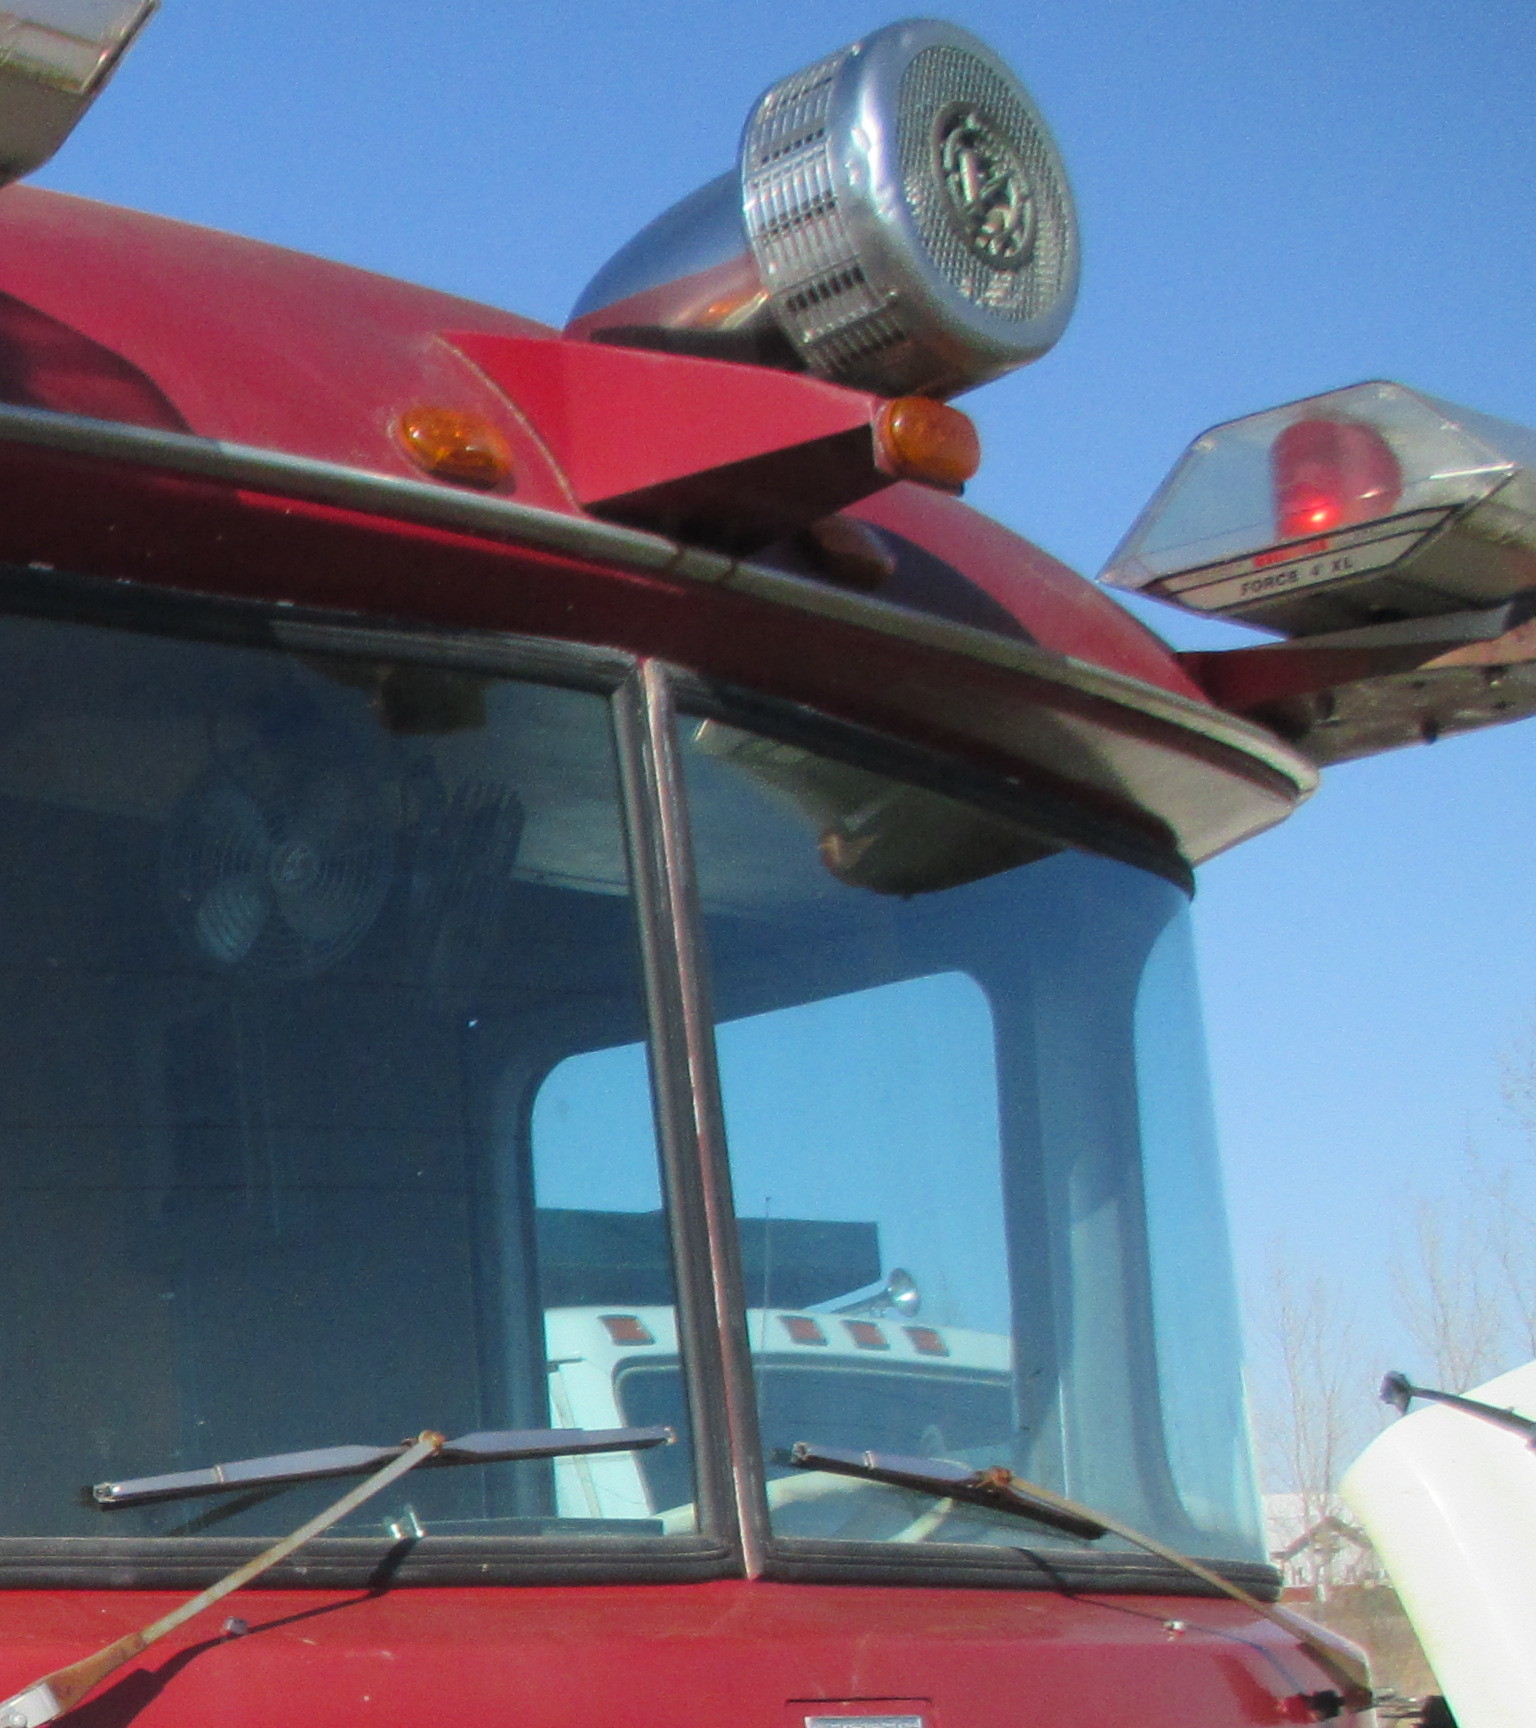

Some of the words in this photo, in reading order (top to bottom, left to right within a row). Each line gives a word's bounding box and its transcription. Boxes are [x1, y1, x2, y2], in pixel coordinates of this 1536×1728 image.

[1240, 569, 1300, 597] FORCE
[1310, 562, 1322, 577] 4
[1331, 556, 1354, 571] XL
